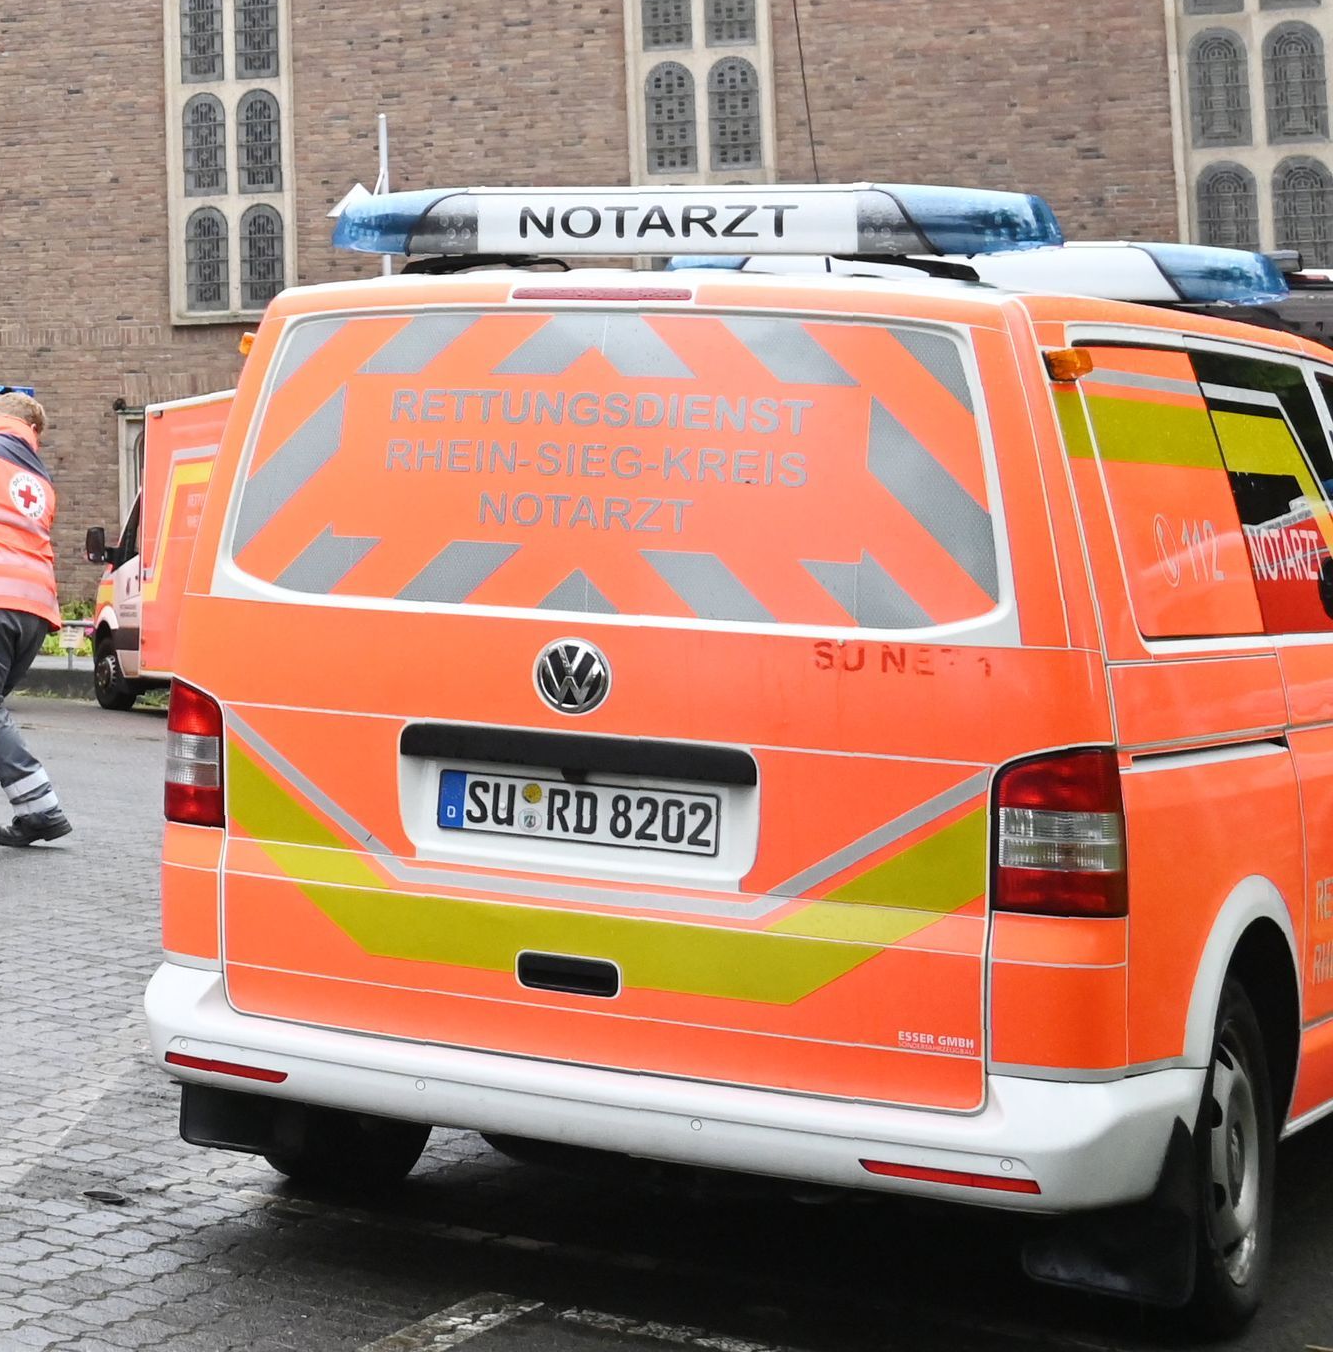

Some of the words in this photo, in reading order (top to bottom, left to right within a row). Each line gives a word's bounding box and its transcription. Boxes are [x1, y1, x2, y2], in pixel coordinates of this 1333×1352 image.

[519, 205, 799, 239] NOTARZT
[389, 388, 814, 436] RETTUNGSDIENST
[385, 438, 808, 488] RHEIN-SIEG-KREIS
[477, 491, 694, 534] NOTARZT
[1181, 519, 1225, 582] 112
[1246, 528, 1325, 582] NOTARZT
[446, 805, 456, 818] D
[465, 780, 517, 826] SU
[546, 787, 598, 835] RD
[609, 794, 712, 847] 8202
[897, 1030, 935, 1045] ESSER
[937, 1035, 975, 1049] GMBH
